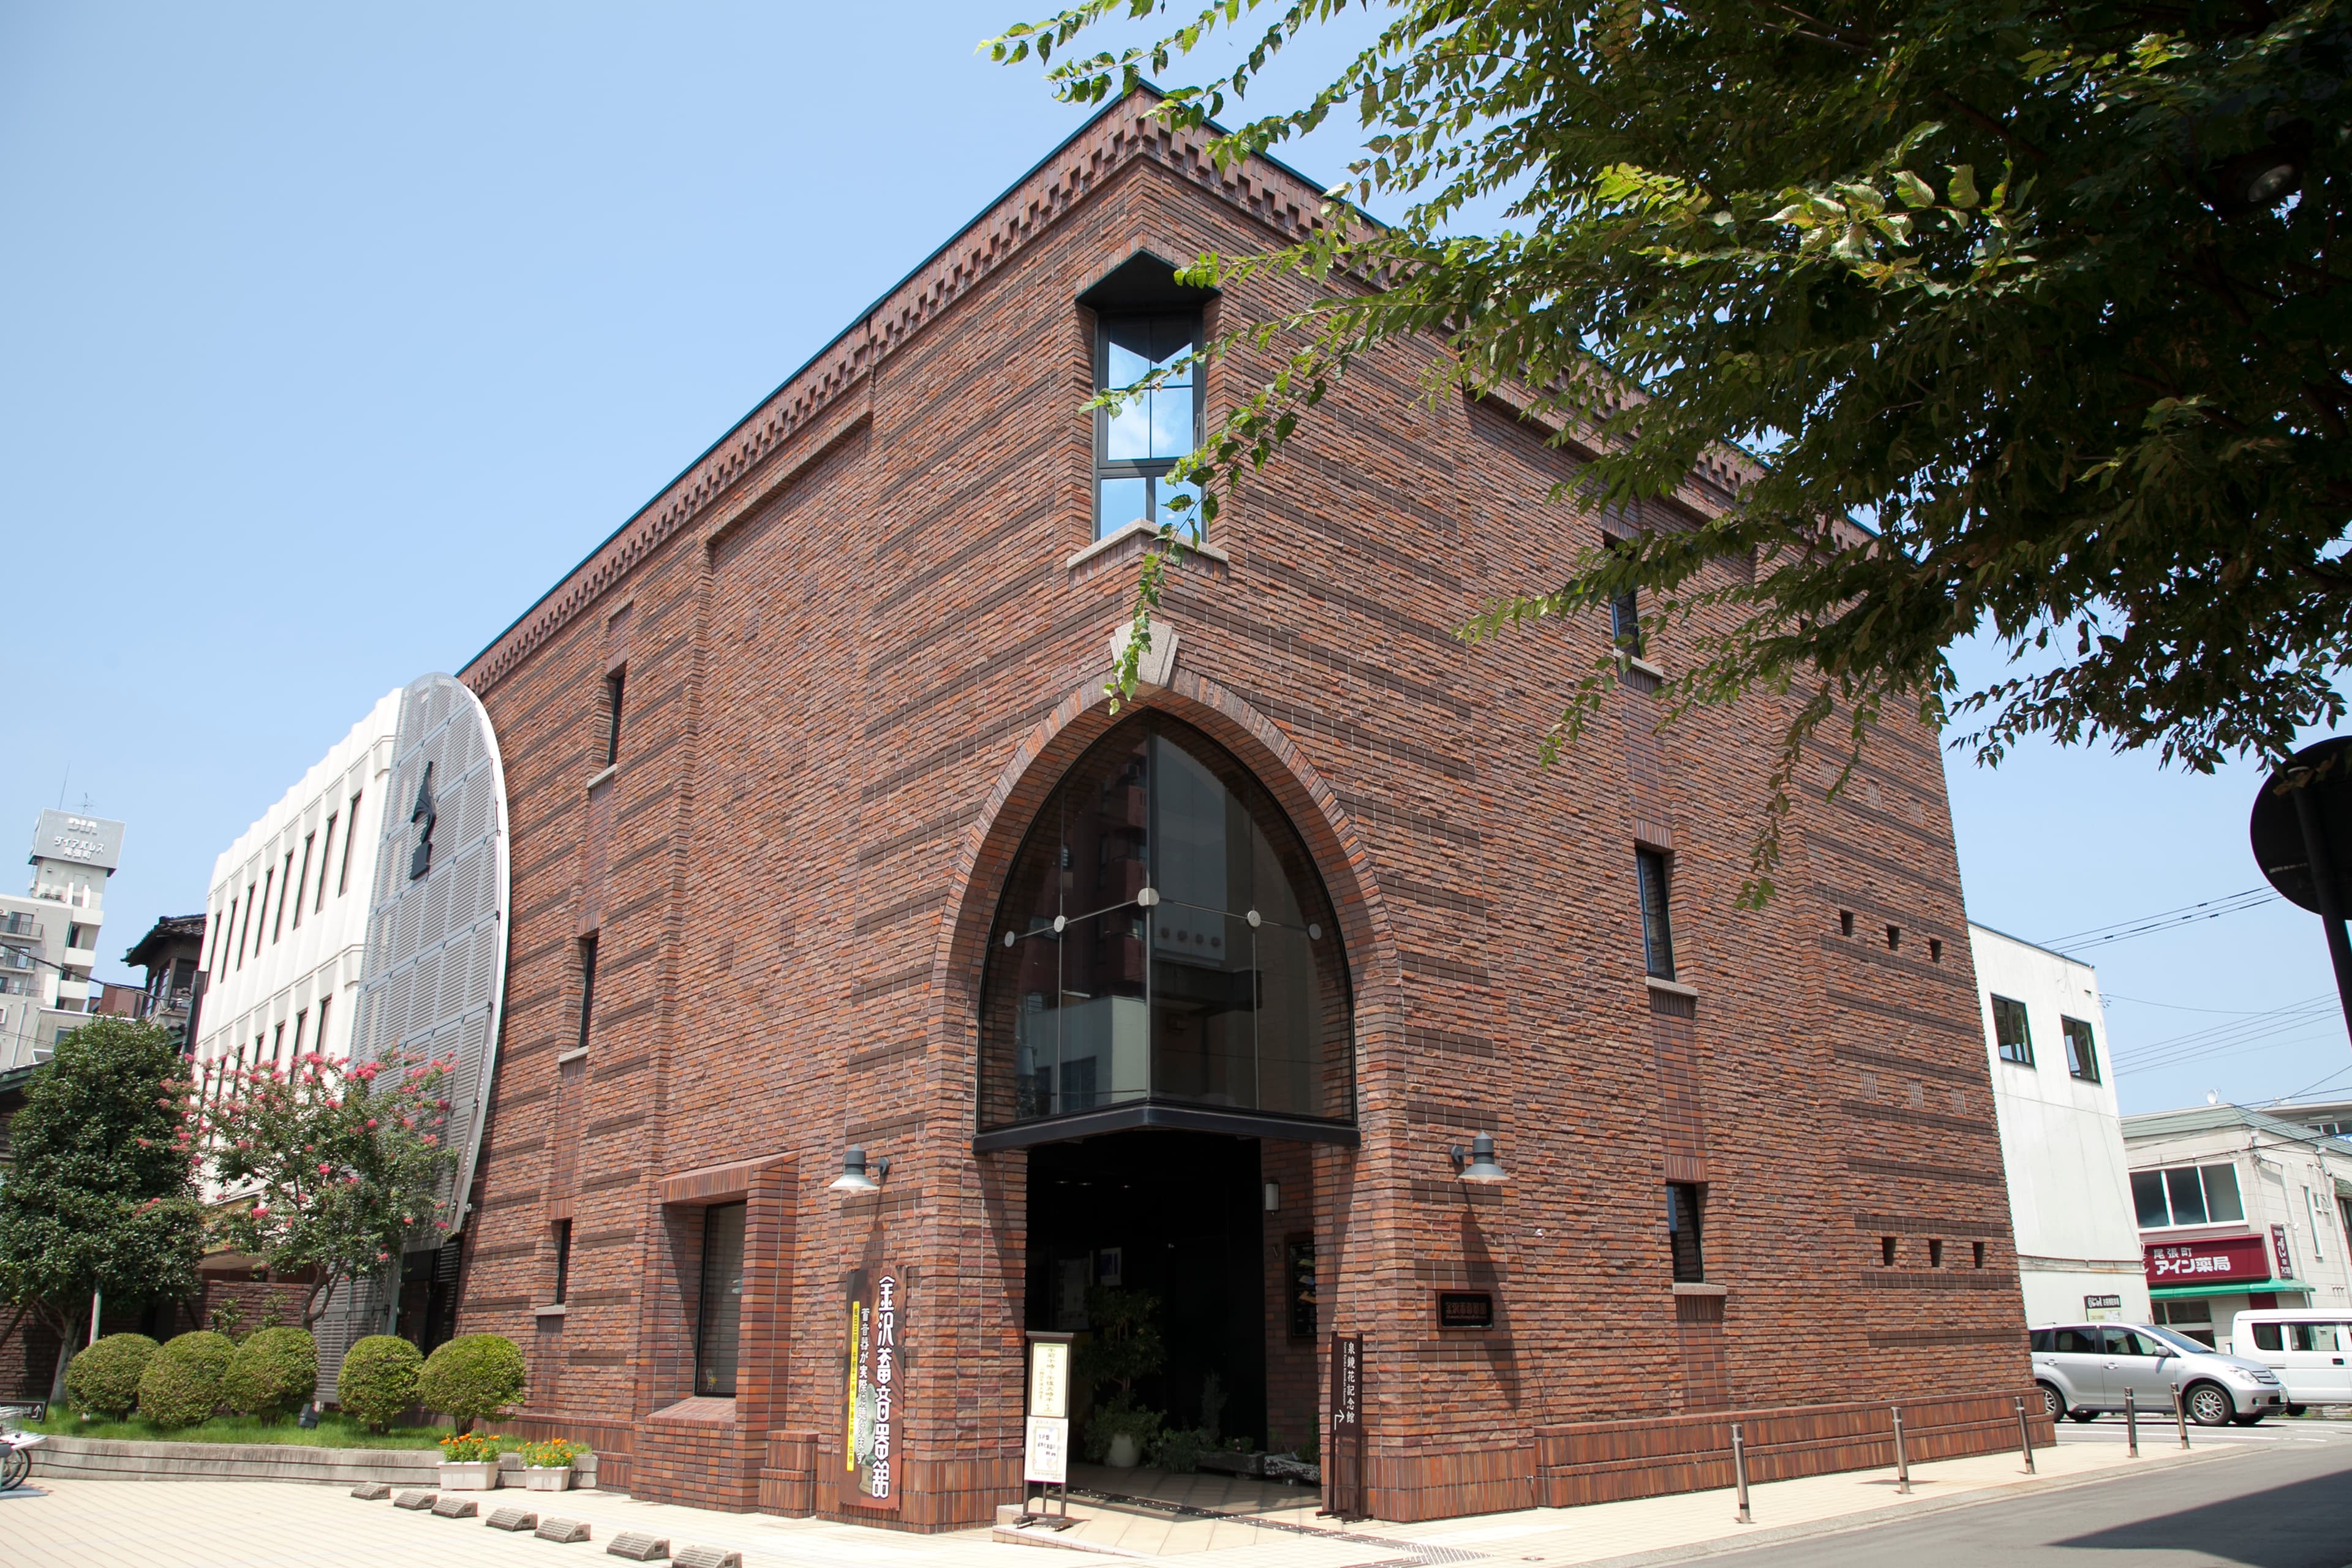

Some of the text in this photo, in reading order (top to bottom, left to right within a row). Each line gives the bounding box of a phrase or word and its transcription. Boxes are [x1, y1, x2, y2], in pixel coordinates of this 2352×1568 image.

[54, 836, 104, 853] ダイアパレス
[64, 847, 92, 859] 尾張町
[2154, 1247, 2192, 1259] 尾張町
[2154, 1256, 2231, 1275] アイン薬局
[856, 1308, 870, 1464] 蓄音器が実際に聴けます
[872, 1276, 895, 1498] 金沢蓄音器館
[1346, 1342, 1355, 1423] 泉鏡花記念館
